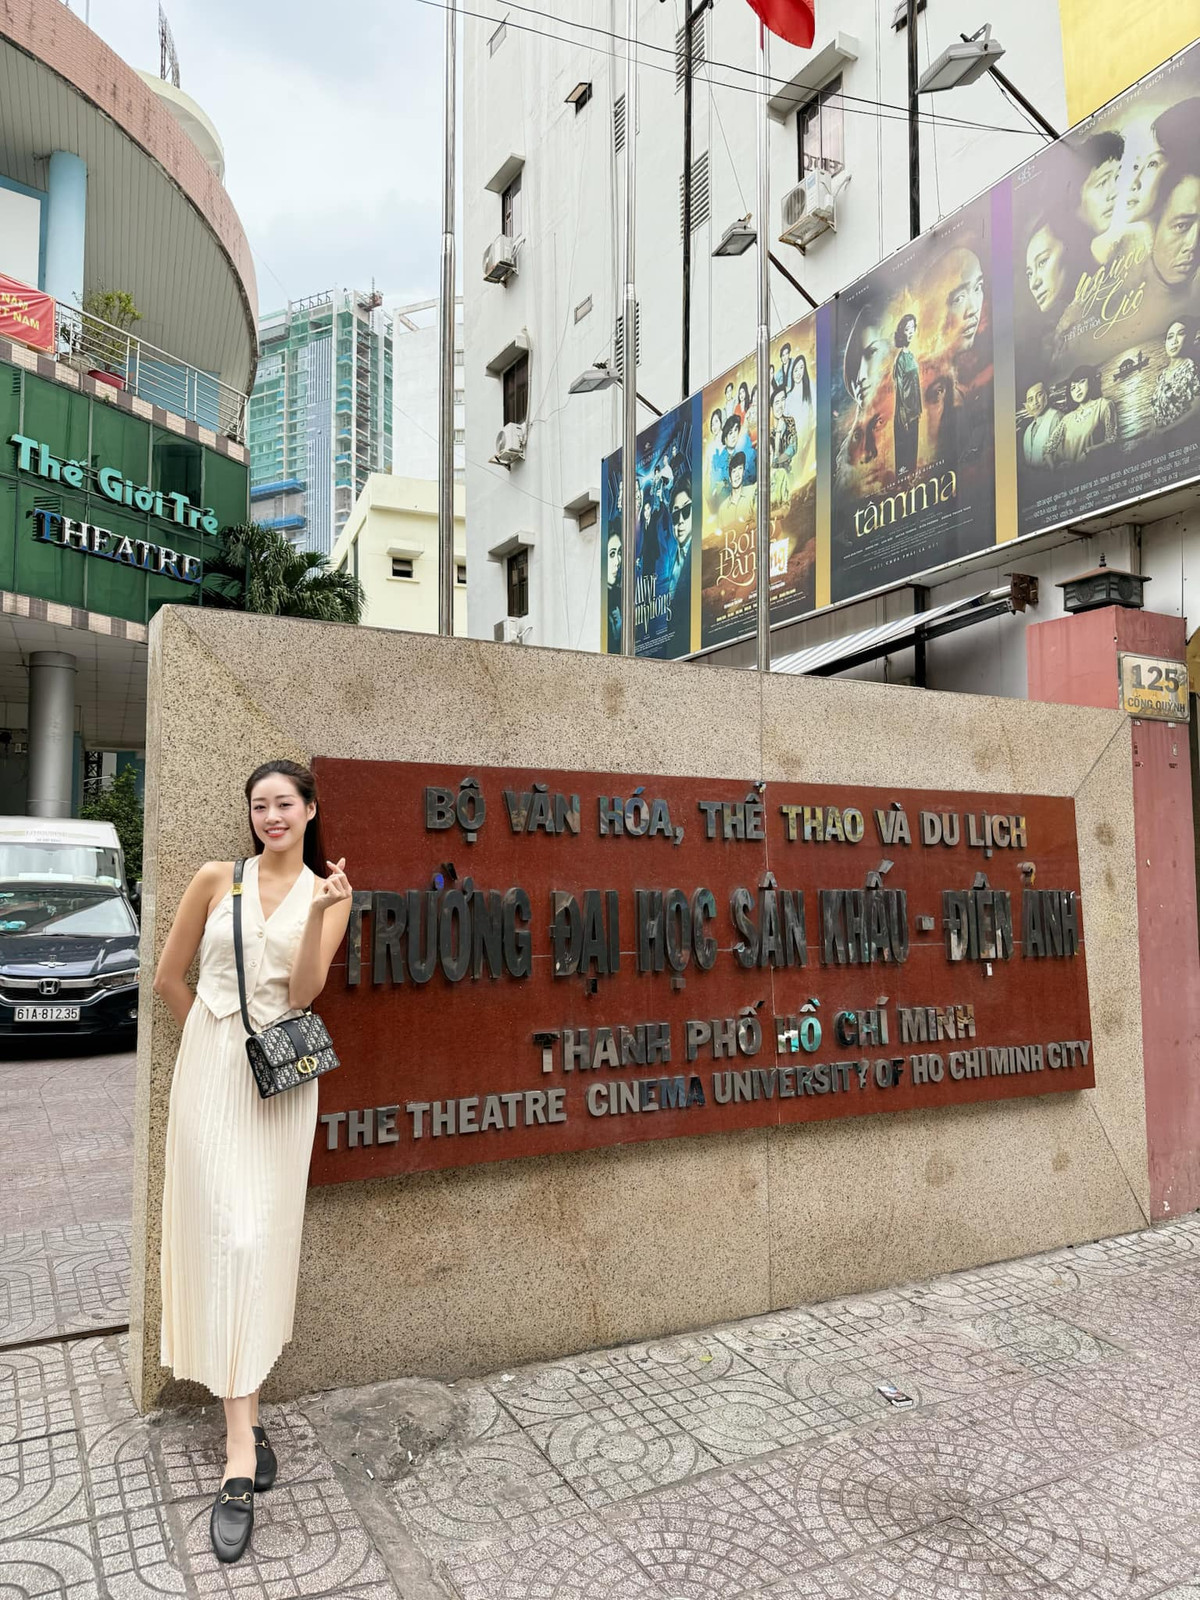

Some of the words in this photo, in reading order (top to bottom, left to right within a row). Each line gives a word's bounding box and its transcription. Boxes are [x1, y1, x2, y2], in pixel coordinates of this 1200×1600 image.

[12, 311, 40, 331] NAM
[11, 433, 88, 488] Thế
[99, 466, 163, 517] Giới
[168, 490, 219, 536] Trẻ
[34, 508, 201, 584] THEATRE
[1131, 664, 1180, 693] 125
[425, 777, 486, 843] BỘ
[503, 783, 581, 834] VĂN
[598, 786, 684, 845] HÓA,
[699, 781, 766, 840] THỂ
[779, 805, 865, 843] THAO
[874, 802, 911, 845] VÀ
[920, 811, 960, 846] DU
[965, 812, 1027, 858] LỊCH
[346, 862, 532, 985] TRƯỜNG
[549, 888, 620, 996] ĐẠI
[634, 887, 718, 990] HỌC
[730, 871, 808, 968] SÂN
[817, 859, 909, 967] KHẤU
[942, 871, 1014, 976] ĐIỆN
[1017, 861, 1080, 960] ẢNH
[17, 1007, 78, 1020] 61A-812.35
[533, 1022, 672, 1074] THANH
[685, 1000, 763, 1062] PHỐ
[775, 998, 822, 1055] HỒ
[834, 996, 890, 1047] CHÍ
[898, 1003, 977, 1044] MINH
[321, 1105, 400, 1150] THE
[406, 1088, 568, 1139] THEATRE
[586, 1076, 707, 1118] CINEMA
[713, 1059, 869, 1105] UNIVERSITY
[875, 1058, 905, 1089] OF
[910, 1053, 944, 1085] HO
[949, 1048, 987, 1081] CHI
[988, 1044, 1044, 1076] MINH
[1047, 1039, 1091, 1070] CITY
